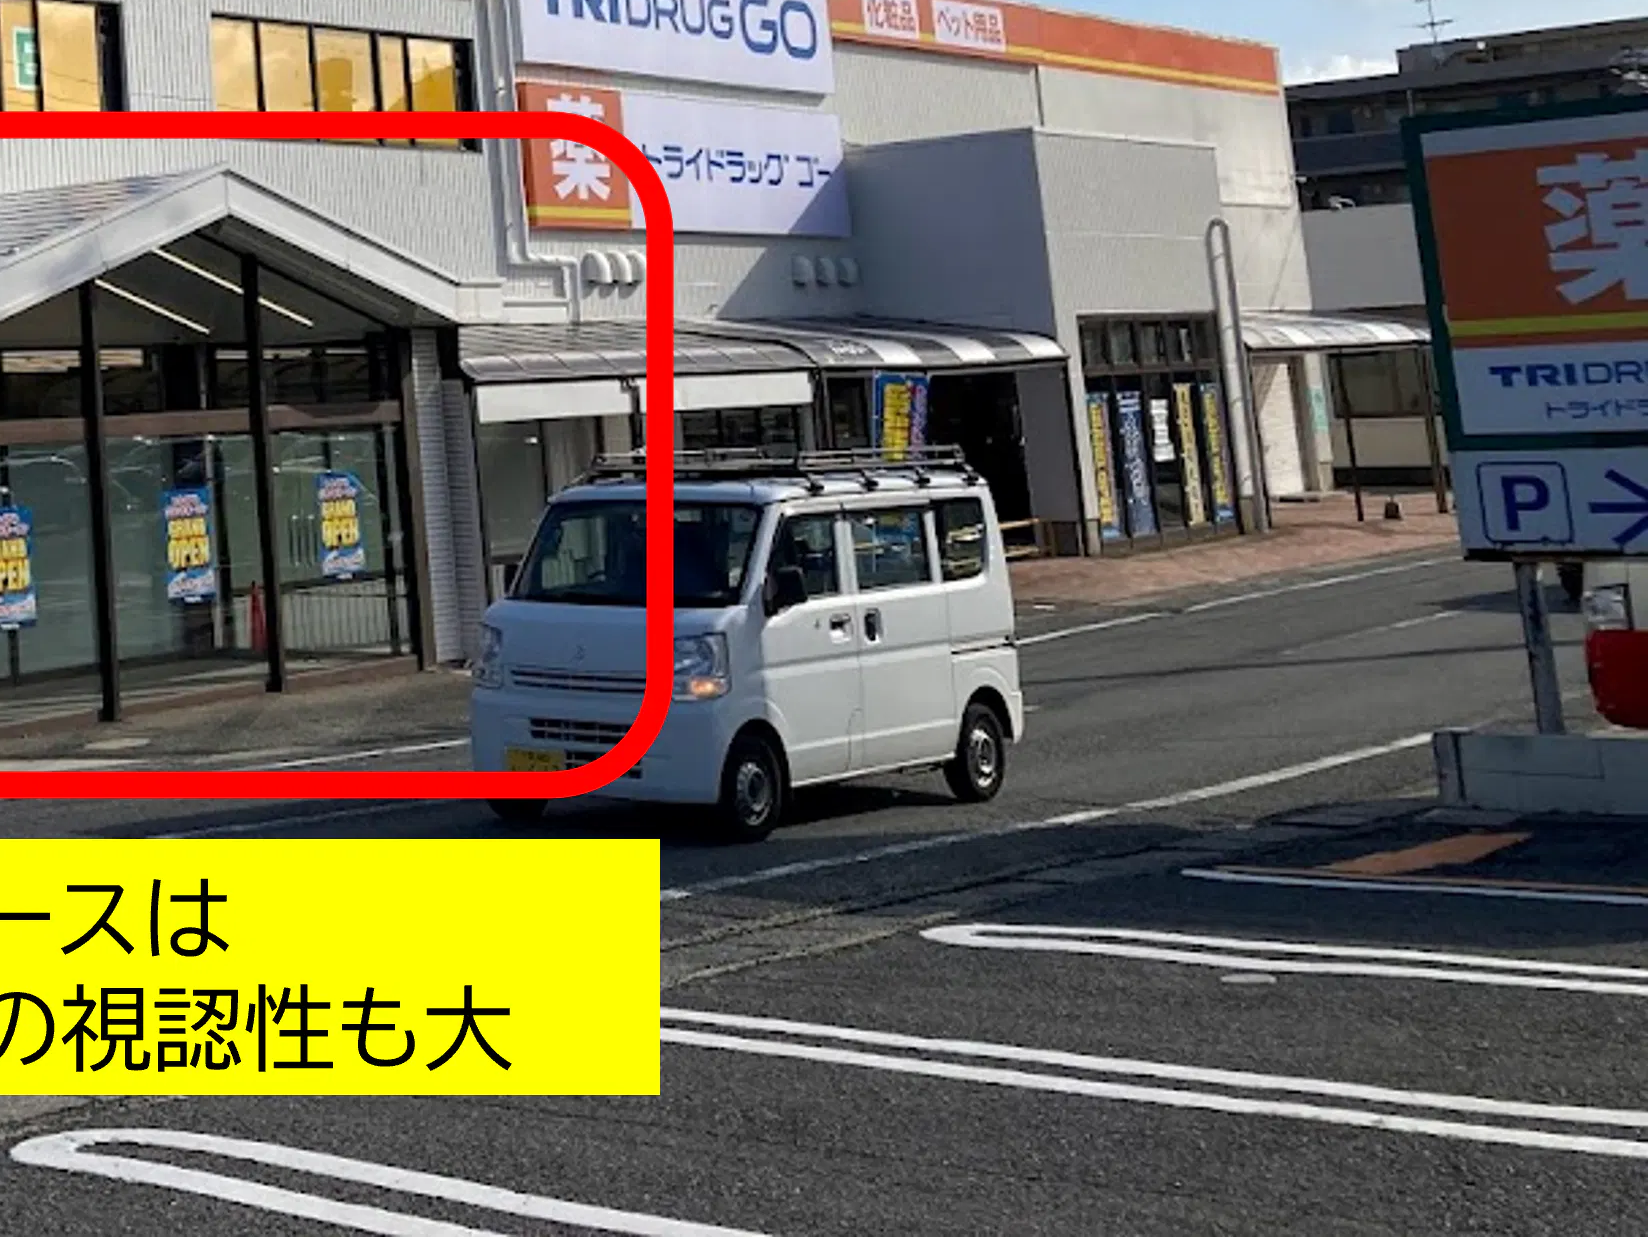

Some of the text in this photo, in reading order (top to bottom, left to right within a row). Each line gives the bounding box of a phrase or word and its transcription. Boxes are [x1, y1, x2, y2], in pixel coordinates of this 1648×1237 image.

[936, 5, 1002, 45] ペット用品
[1488, 360, 1648, 388] TRIDR
[1500, 475, 1550, 532] P
